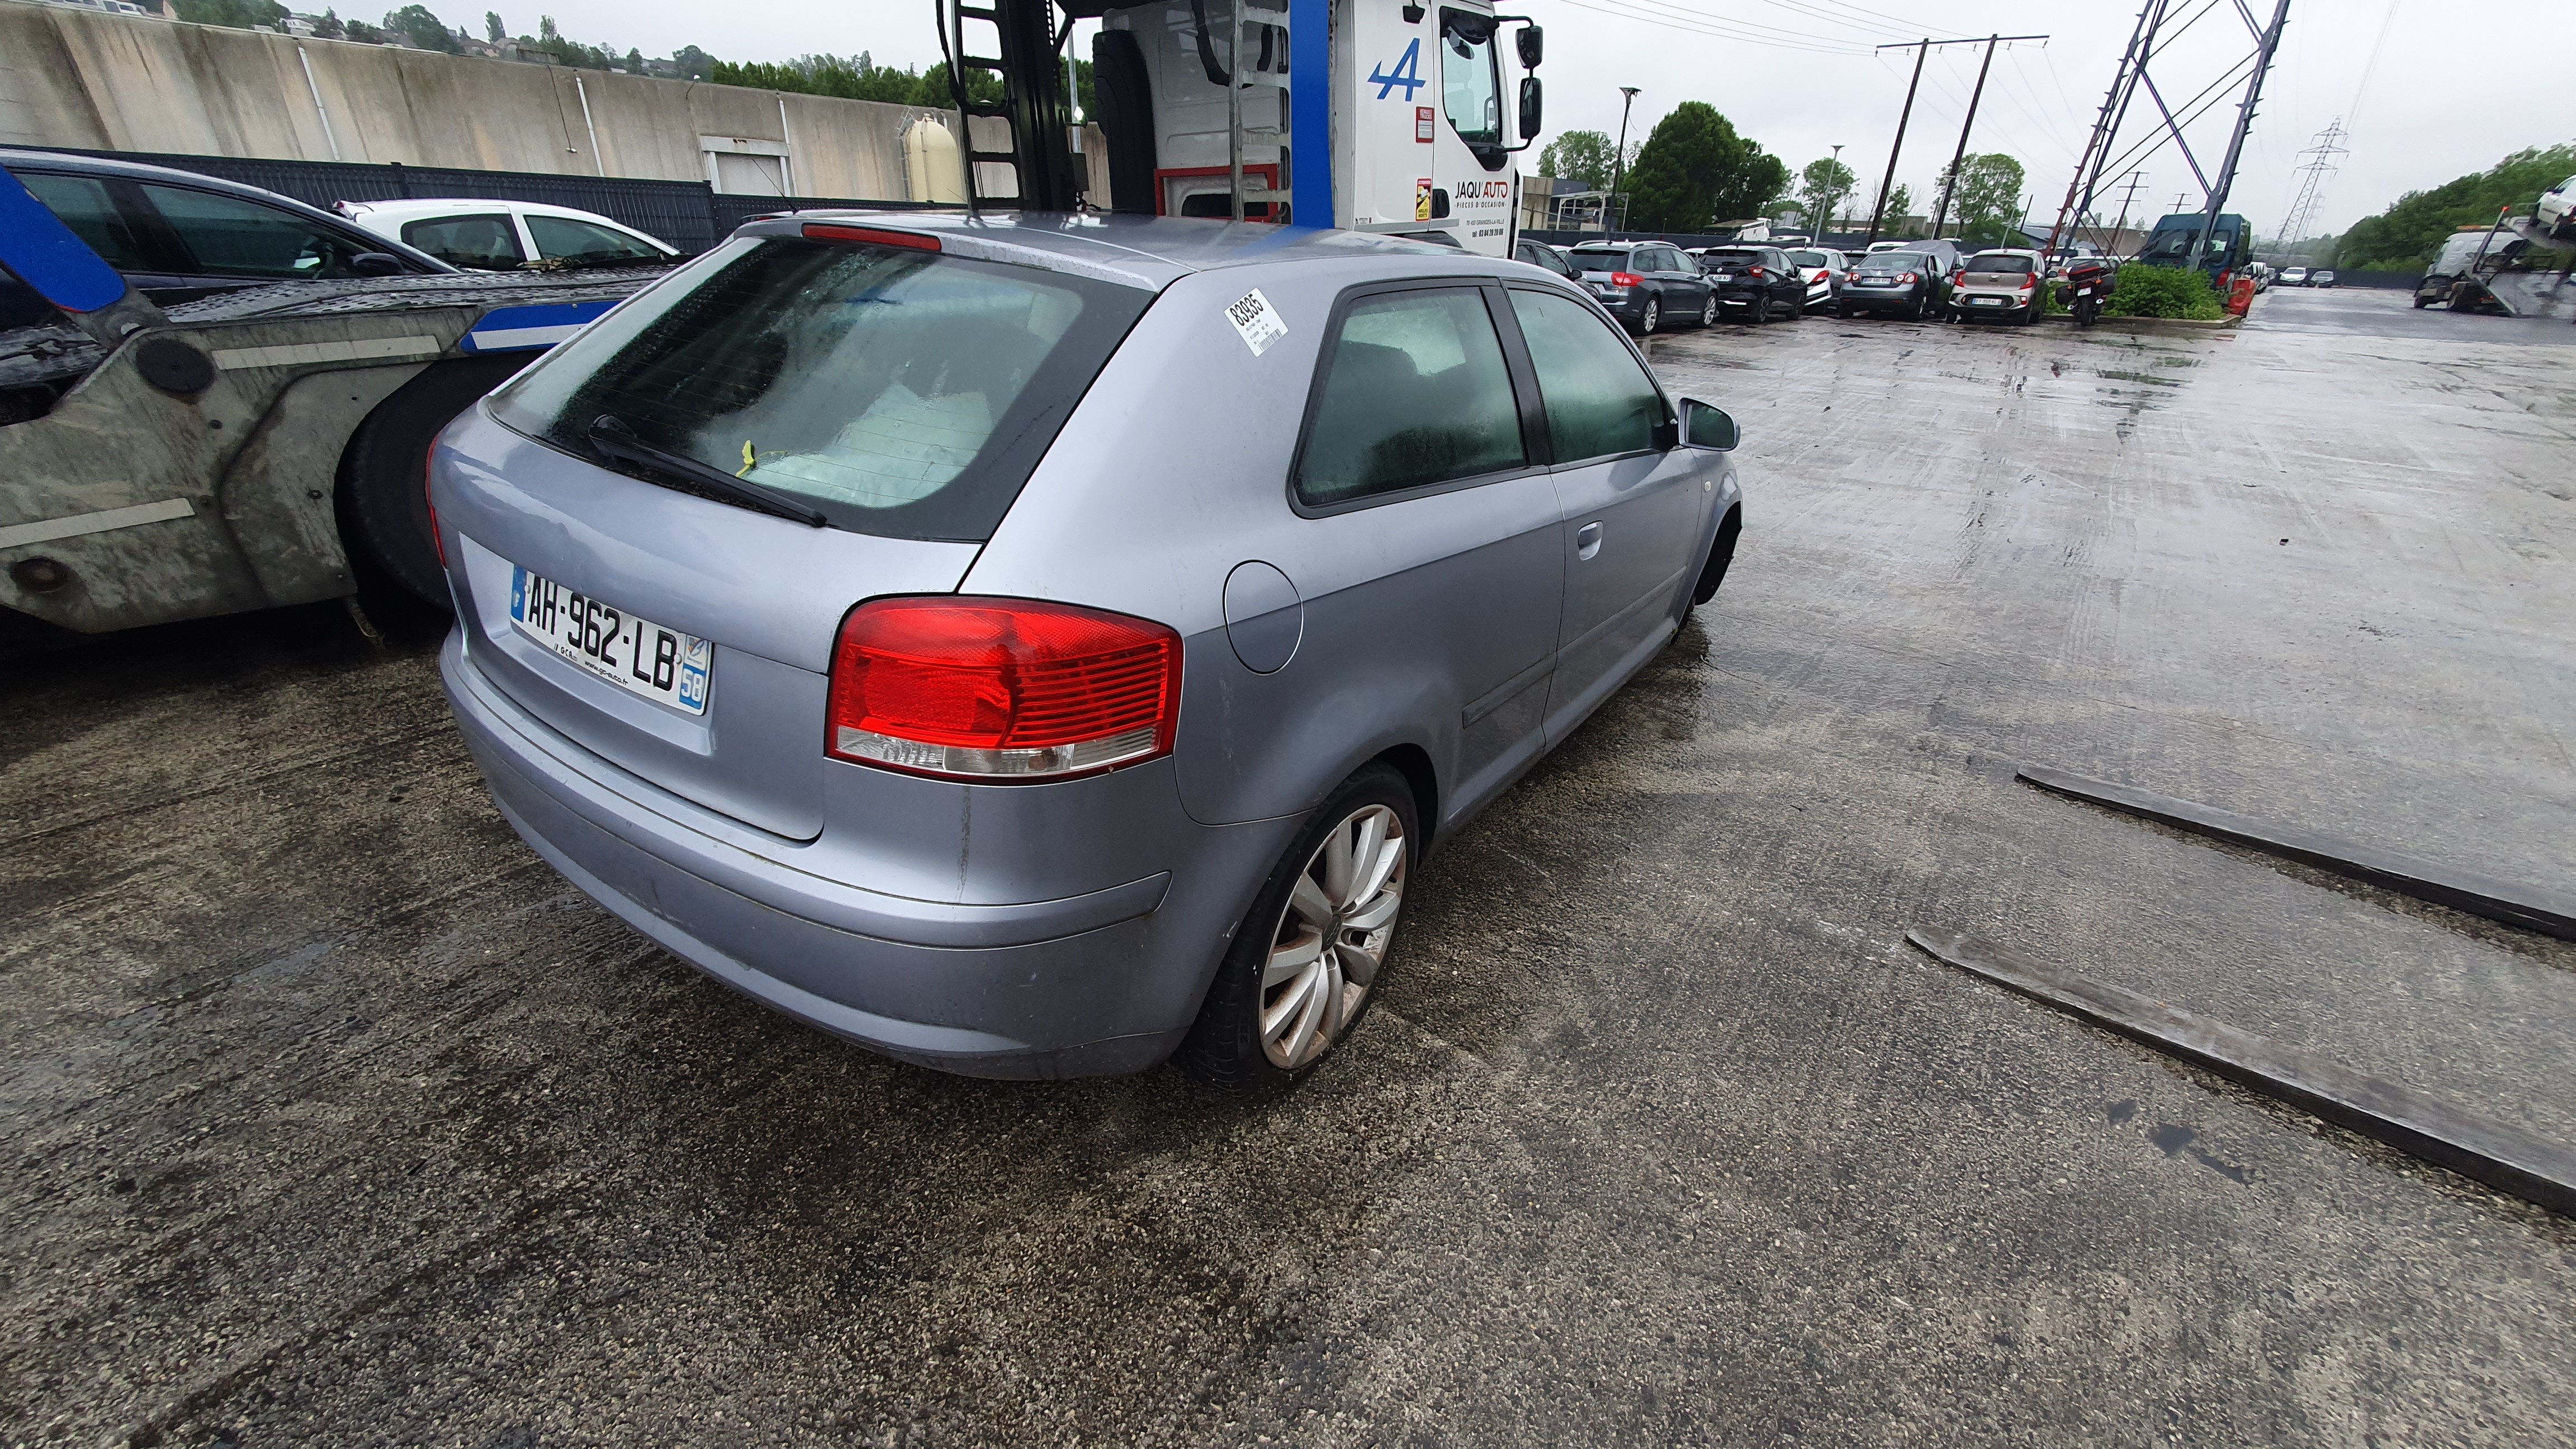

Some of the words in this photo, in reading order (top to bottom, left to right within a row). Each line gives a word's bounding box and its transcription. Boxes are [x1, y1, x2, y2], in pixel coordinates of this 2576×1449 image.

[1230, 293, 1263, 326] 83935
[529, 574, 678, 692] AH-962-LB
[681, 668, 704, 702] 58
